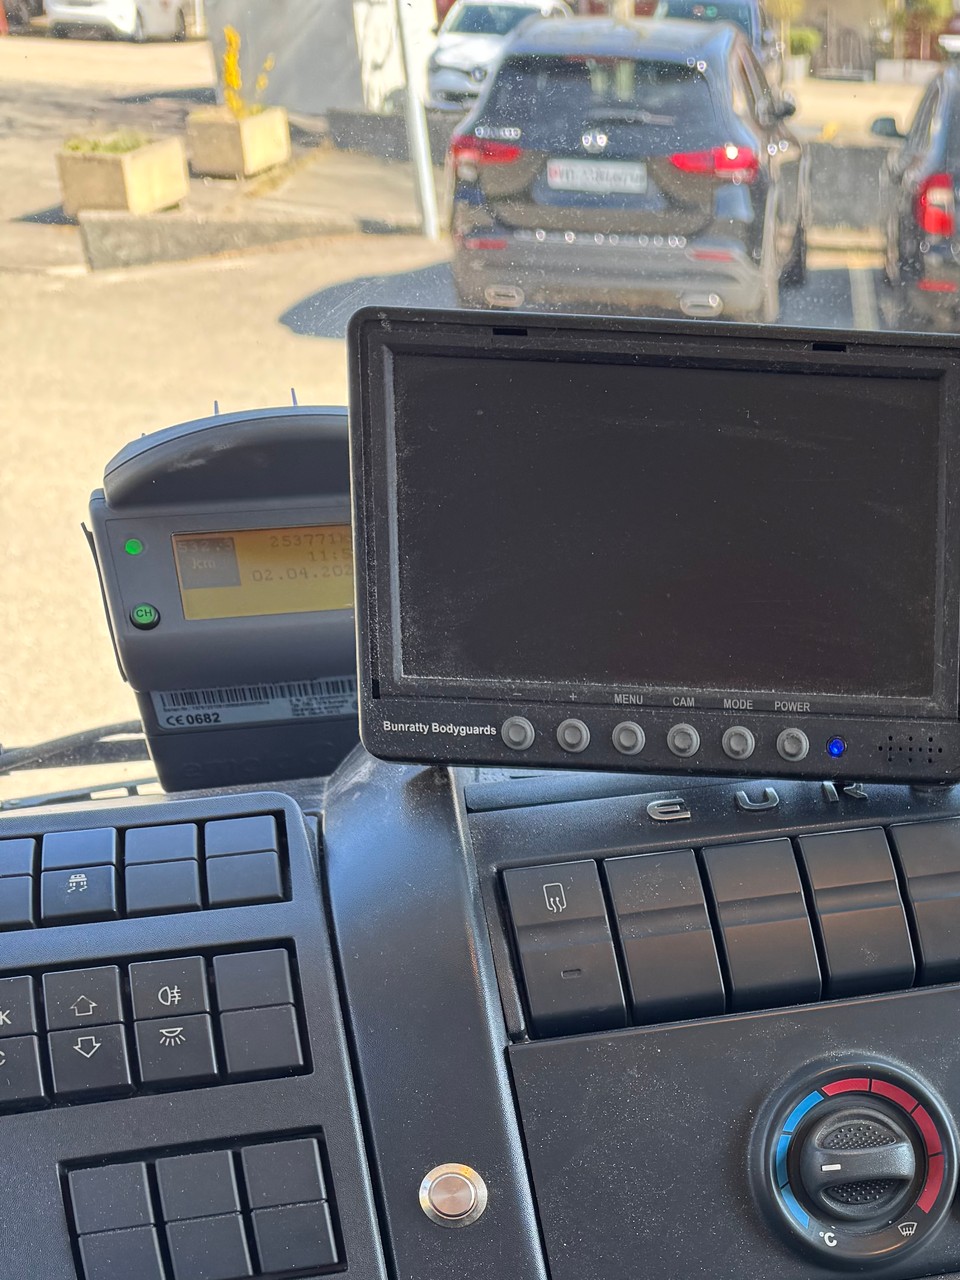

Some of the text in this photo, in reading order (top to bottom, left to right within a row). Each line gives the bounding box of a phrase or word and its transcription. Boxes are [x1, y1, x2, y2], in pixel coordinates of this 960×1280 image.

[252, 564, 353, 582] 02.04.202
[135, 607, 153, 619] CH
[614, 693, 644, 705] MENU
[672, 696, 695, 708] CAM
[723, 698, 753, 710] MODE
[774, 700, 811, 712] POWER
[186, 712, 221, 725] 0682
[383, 720, 497, 736] Bunratty Bodyguards
